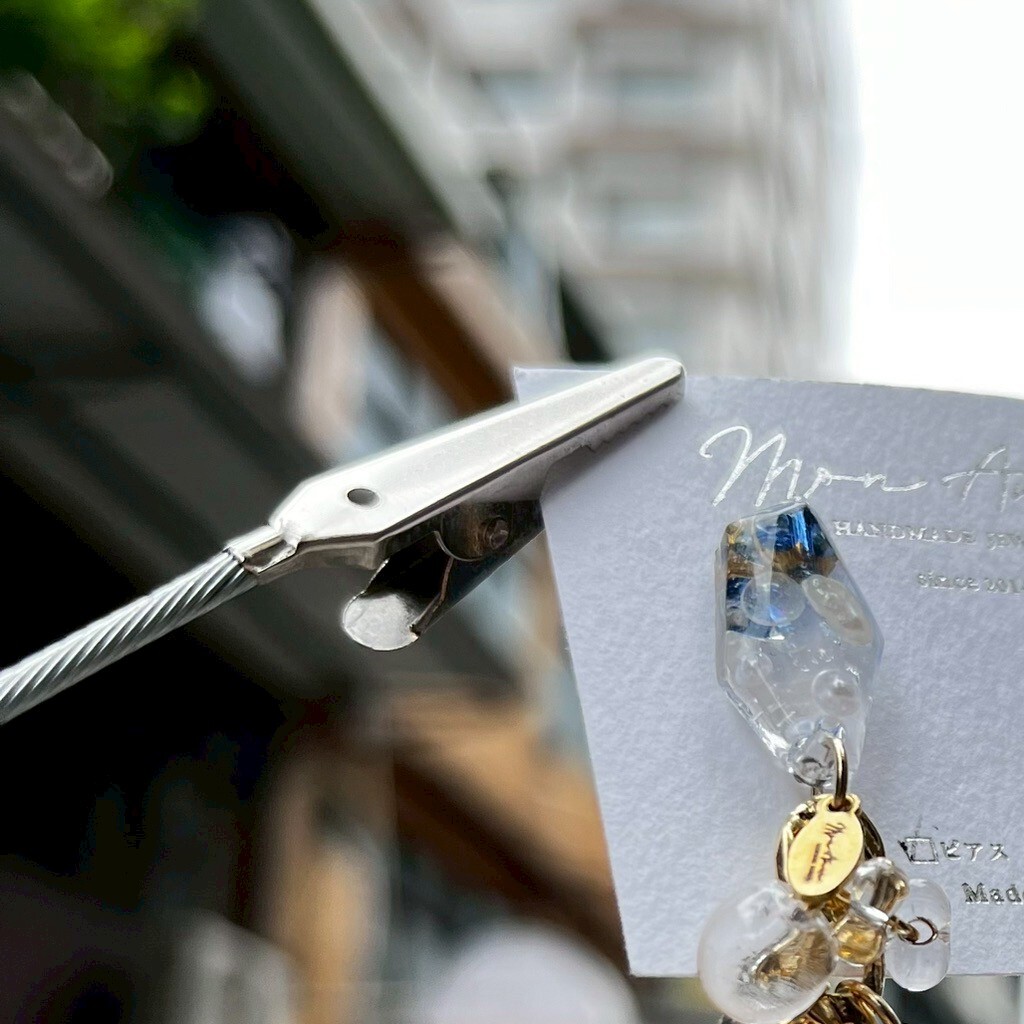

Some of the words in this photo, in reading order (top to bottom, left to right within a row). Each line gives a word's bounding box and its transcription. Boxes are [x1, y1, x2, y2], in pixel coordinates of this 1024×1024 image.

[698, 425, 928, 508] Mon
[832, 519, 977, 545] HANDMADE
[916, 570, 981, 592] since
[940, 839, 1010, 863] ピアス
